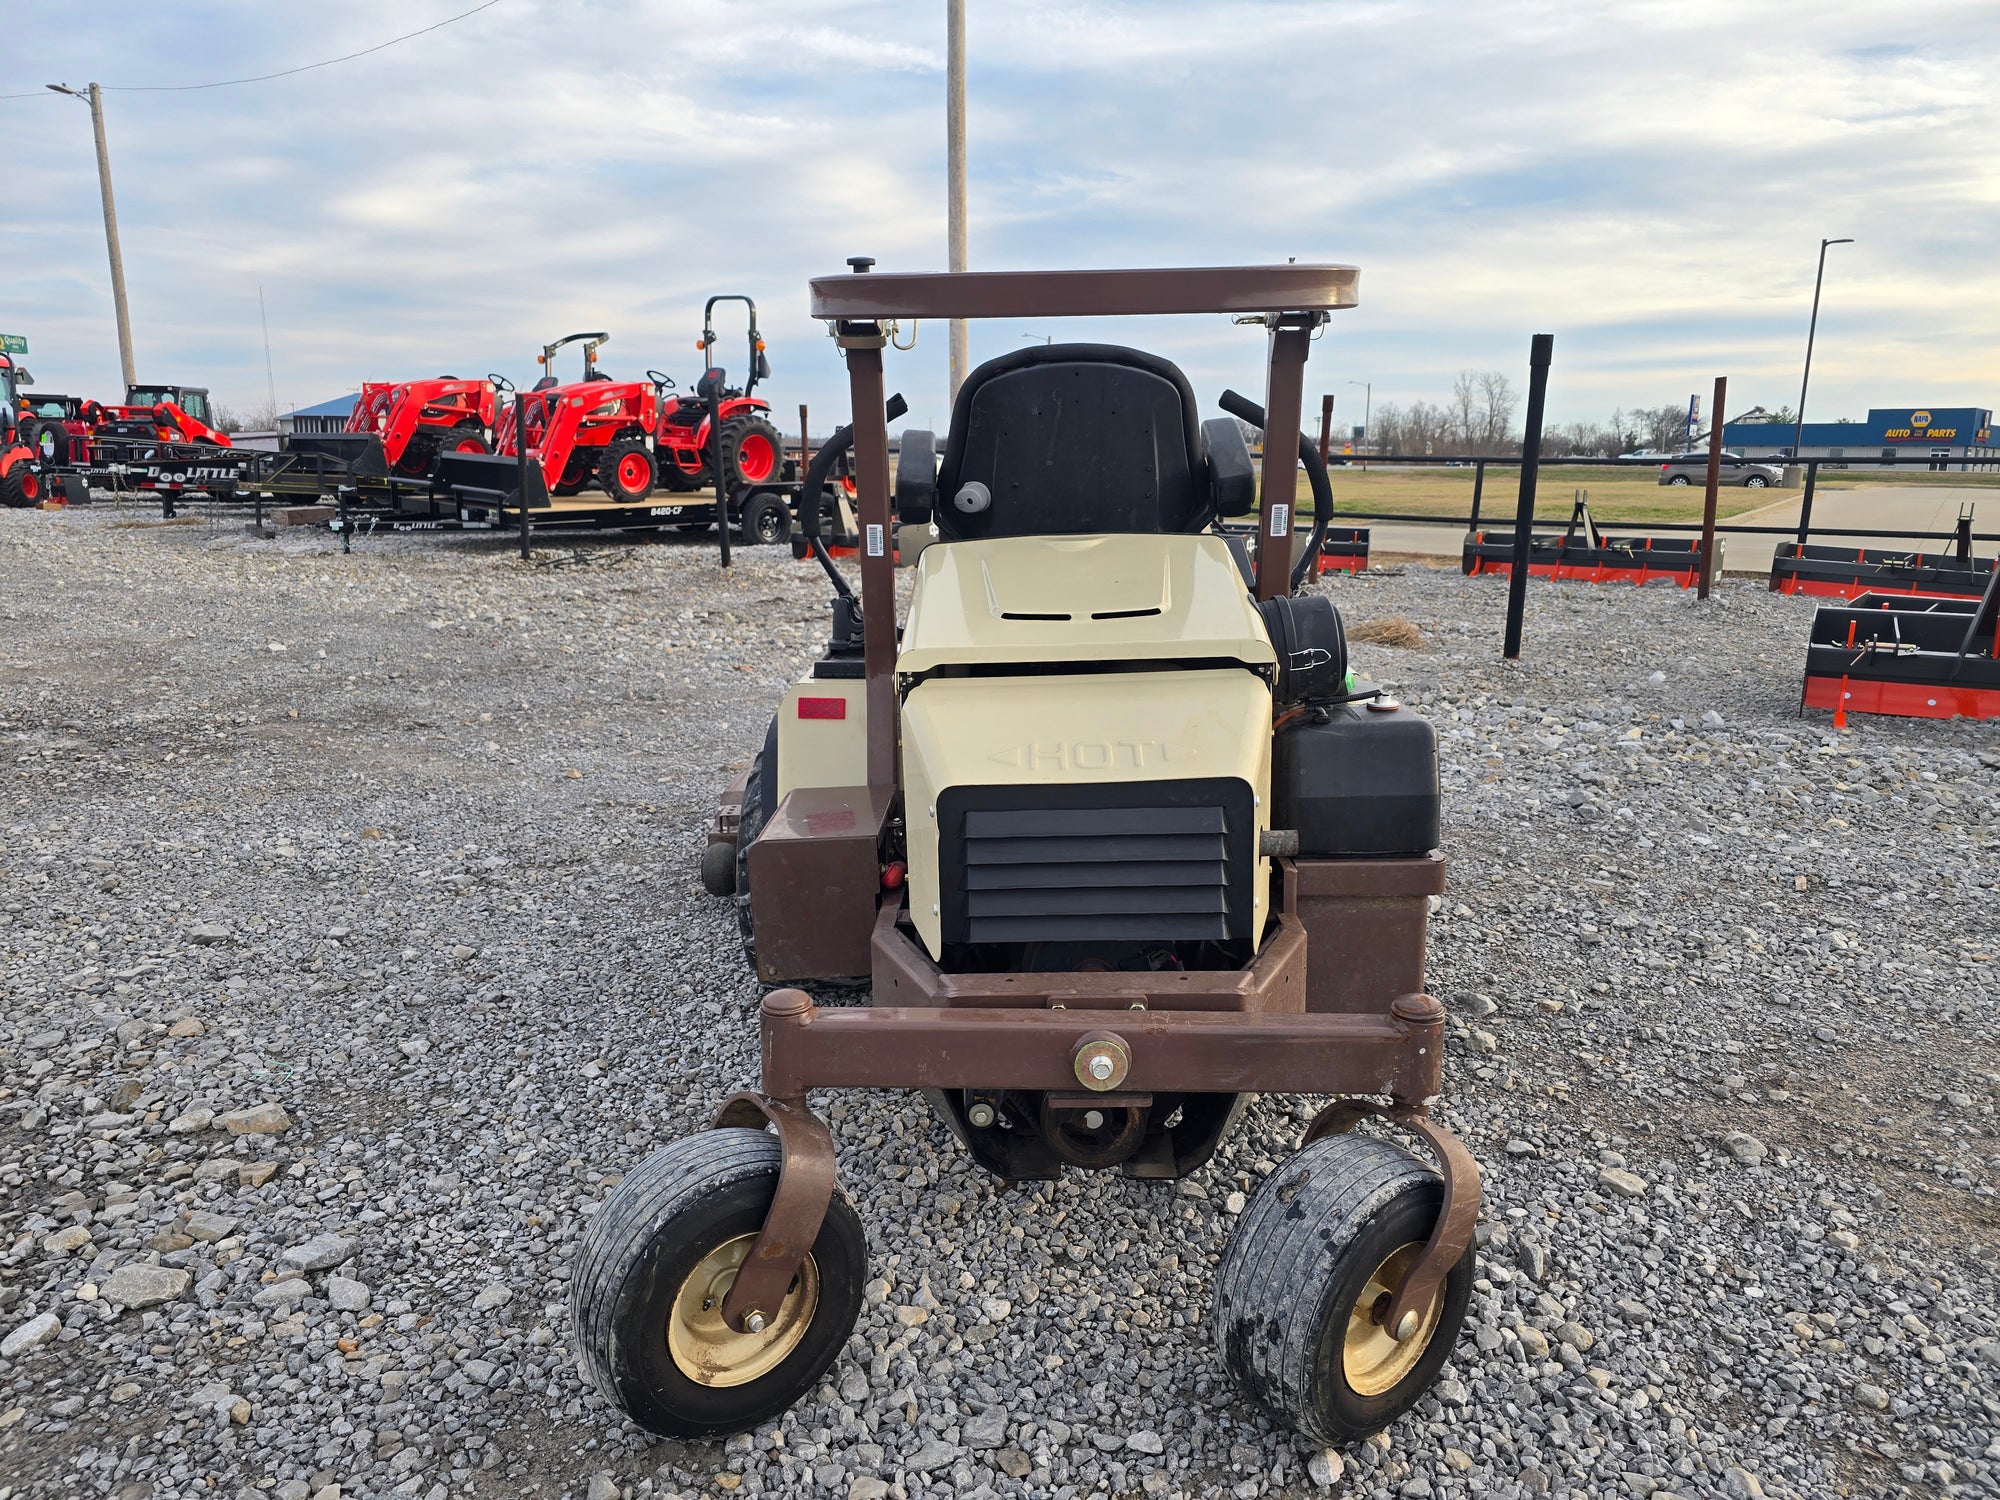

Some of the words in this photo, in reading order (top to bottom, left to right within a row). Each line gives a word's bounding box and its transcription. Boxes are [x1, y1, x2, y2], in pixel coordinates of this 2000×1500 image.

[1913, 415, 1929, 423] NAPA
[1885, 429, 1910, 438] AUTO
[1926, 429, 1957, 438] PARTS
[1027, 740, 1157, 771] HOT
